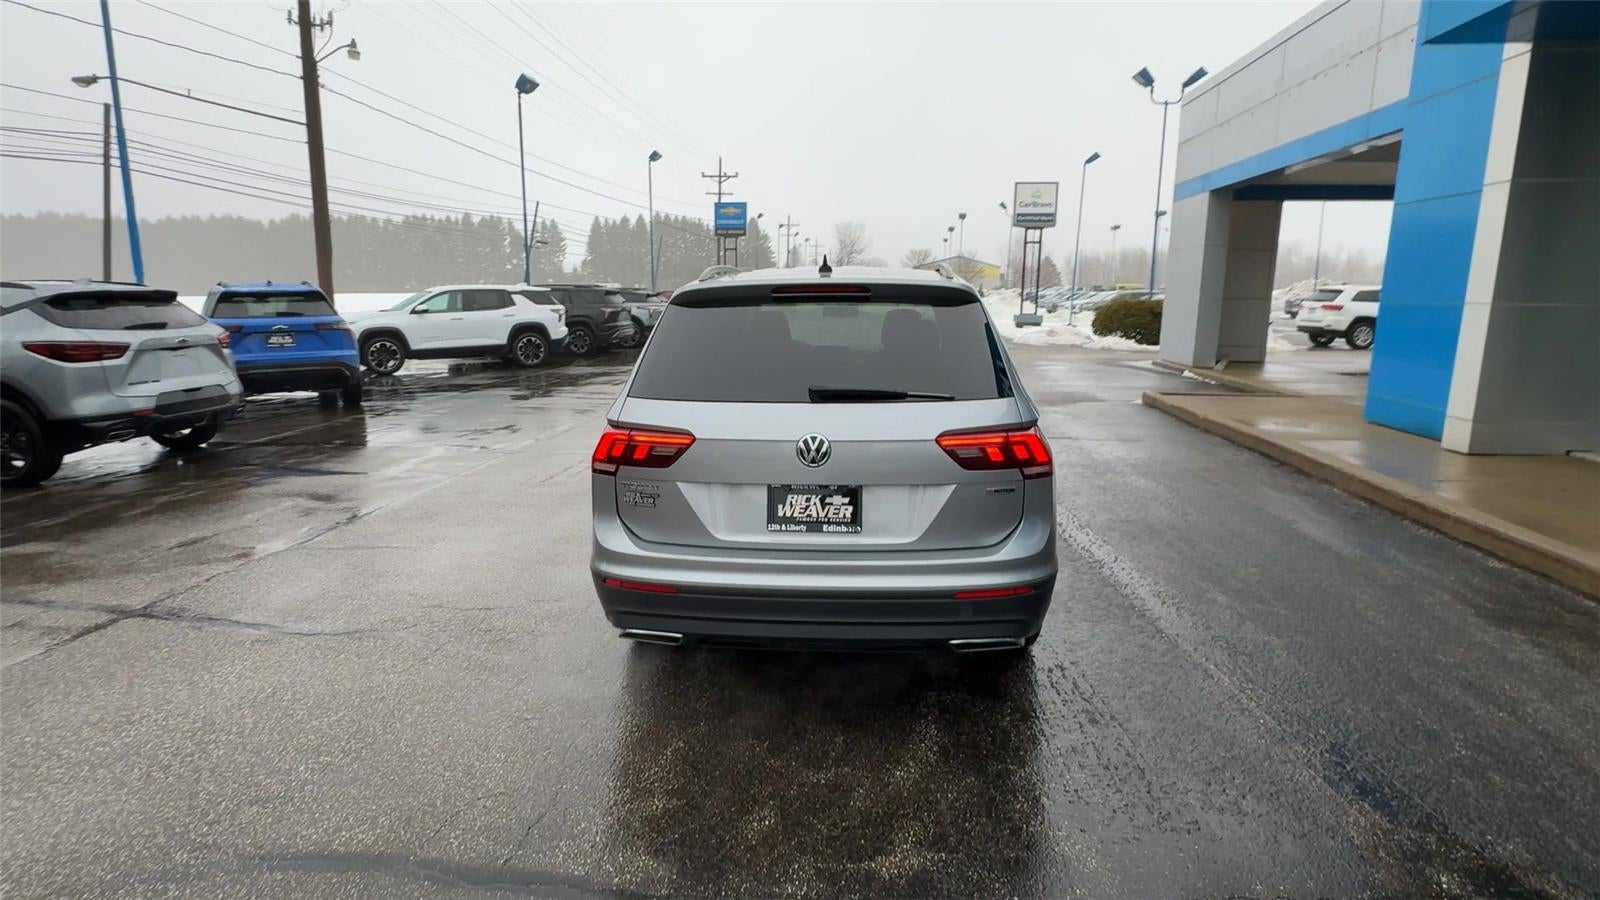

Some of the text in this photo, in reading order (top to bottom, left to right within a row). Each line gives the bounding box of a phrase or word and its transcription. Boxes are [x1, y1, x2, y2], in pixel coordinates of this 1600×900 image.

[785, 494, 822, 506] RICK
[777, 504, 854, 518] WEAVER
[787, 524, 807, 532] Liberty
